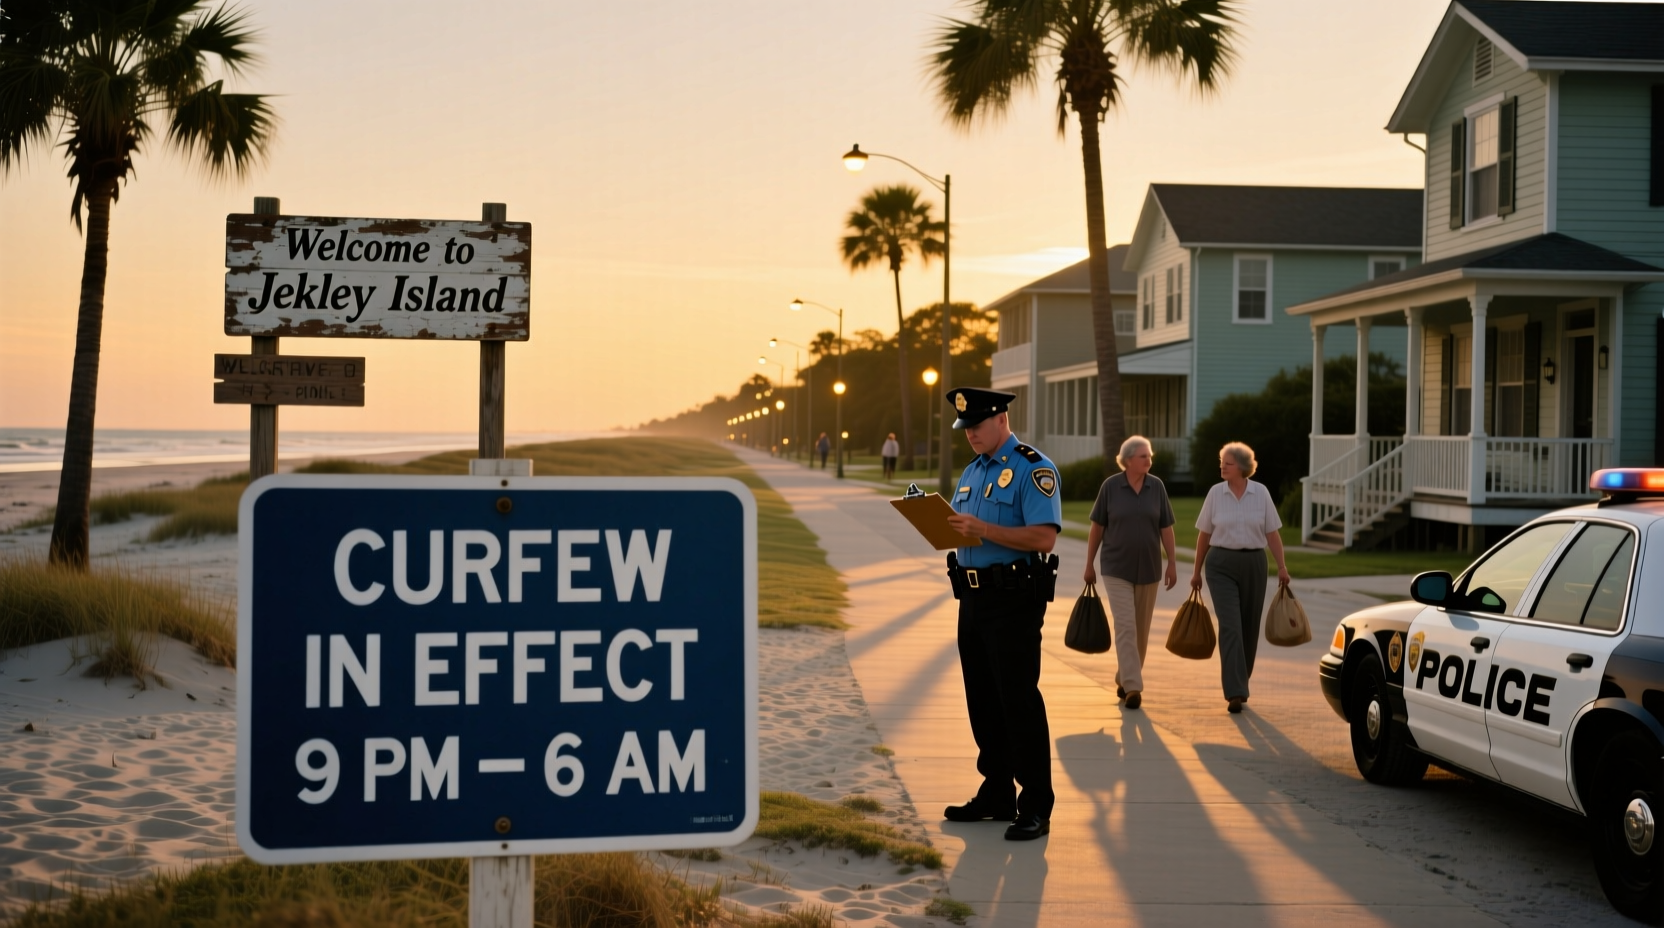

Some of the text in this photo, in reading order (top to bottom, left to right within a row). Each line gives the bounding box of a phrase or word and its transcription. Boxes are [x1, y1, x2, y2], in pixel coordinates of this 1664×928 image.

[285, 226, 475, 265] Welcome to
[247, 271, 508, 324] Jekley Island
[333, 528, 673, 606] CURFEW
[305, 628, 699, 709] IN EFFECT
[1415, 648, 1558, 727] POLICE
[295, 738, 340, 805] 9
[363, 735, 460, 802] PM
[544, 732, 585, 797] 6
[605, 729, 706, 796] AM
